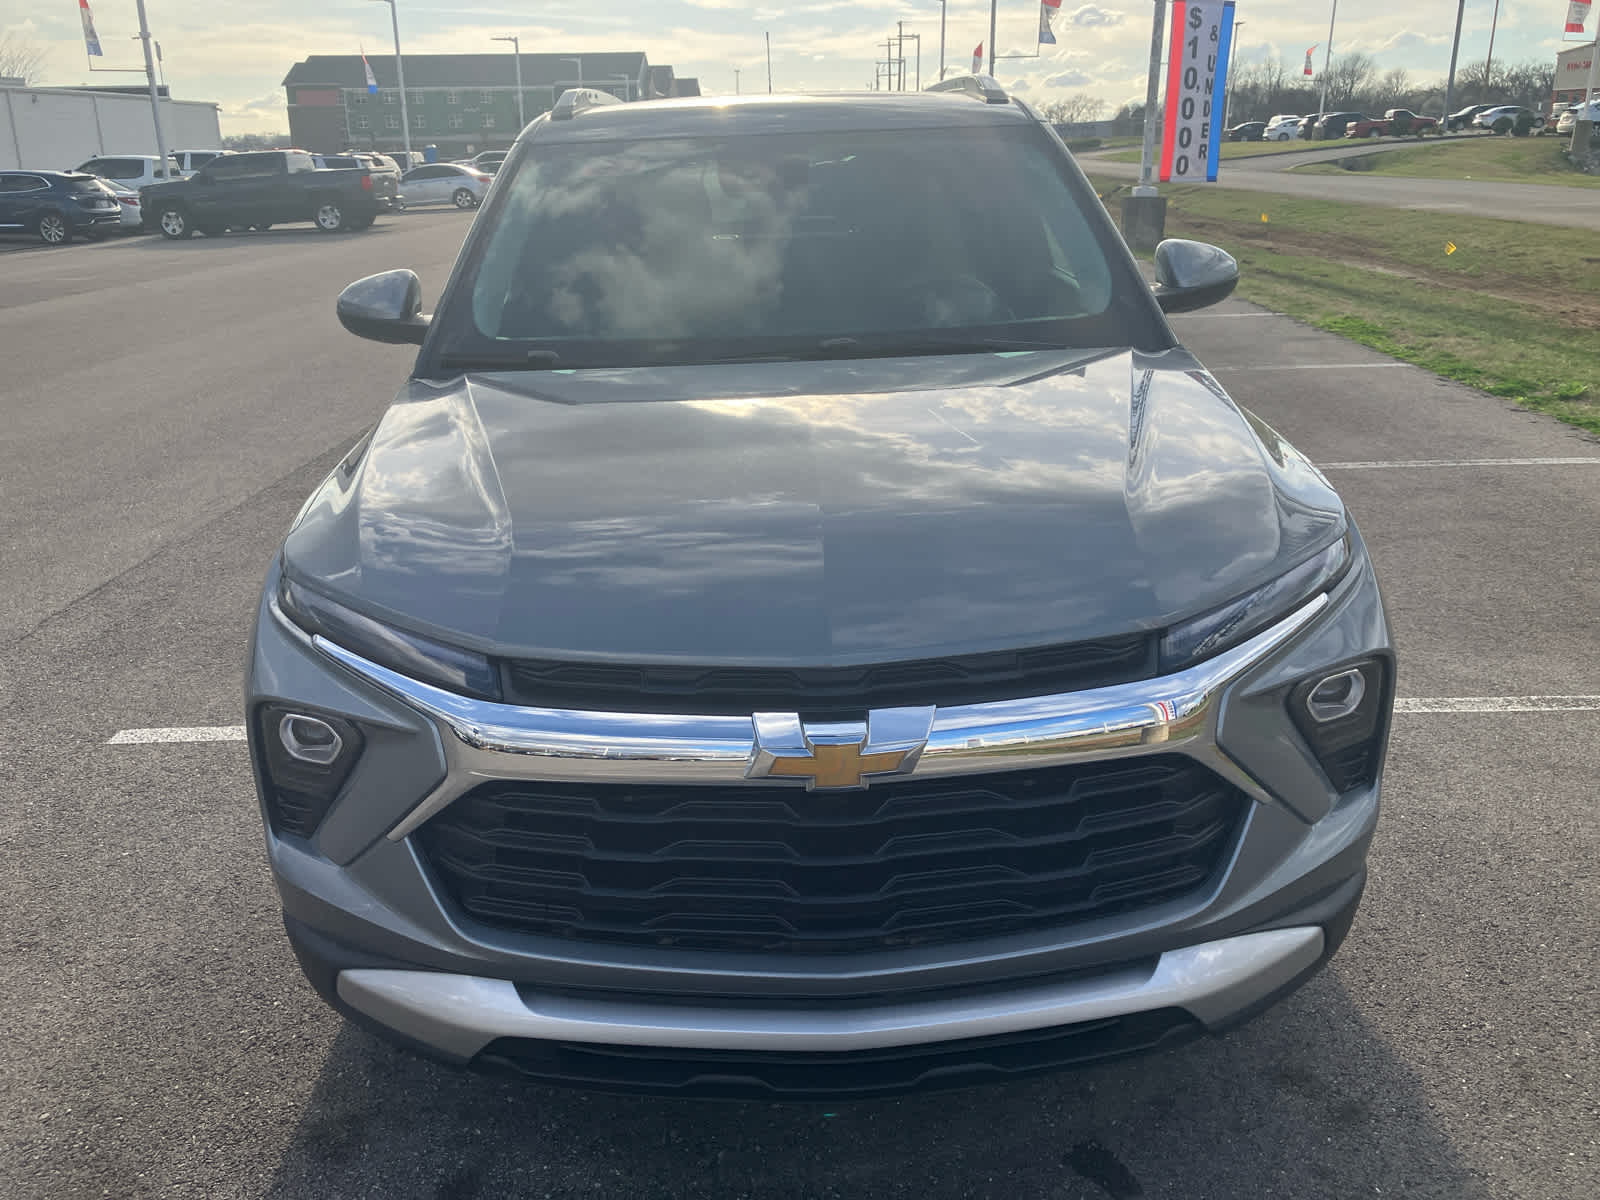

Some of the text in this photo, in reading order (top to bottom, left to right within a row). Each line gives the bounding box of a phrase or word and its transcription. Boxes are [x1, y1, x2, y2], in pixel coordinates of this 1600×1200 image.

[1176, 7, 1202, 176] $10,000
[1198, 25, 1218, 160] & UNDER
